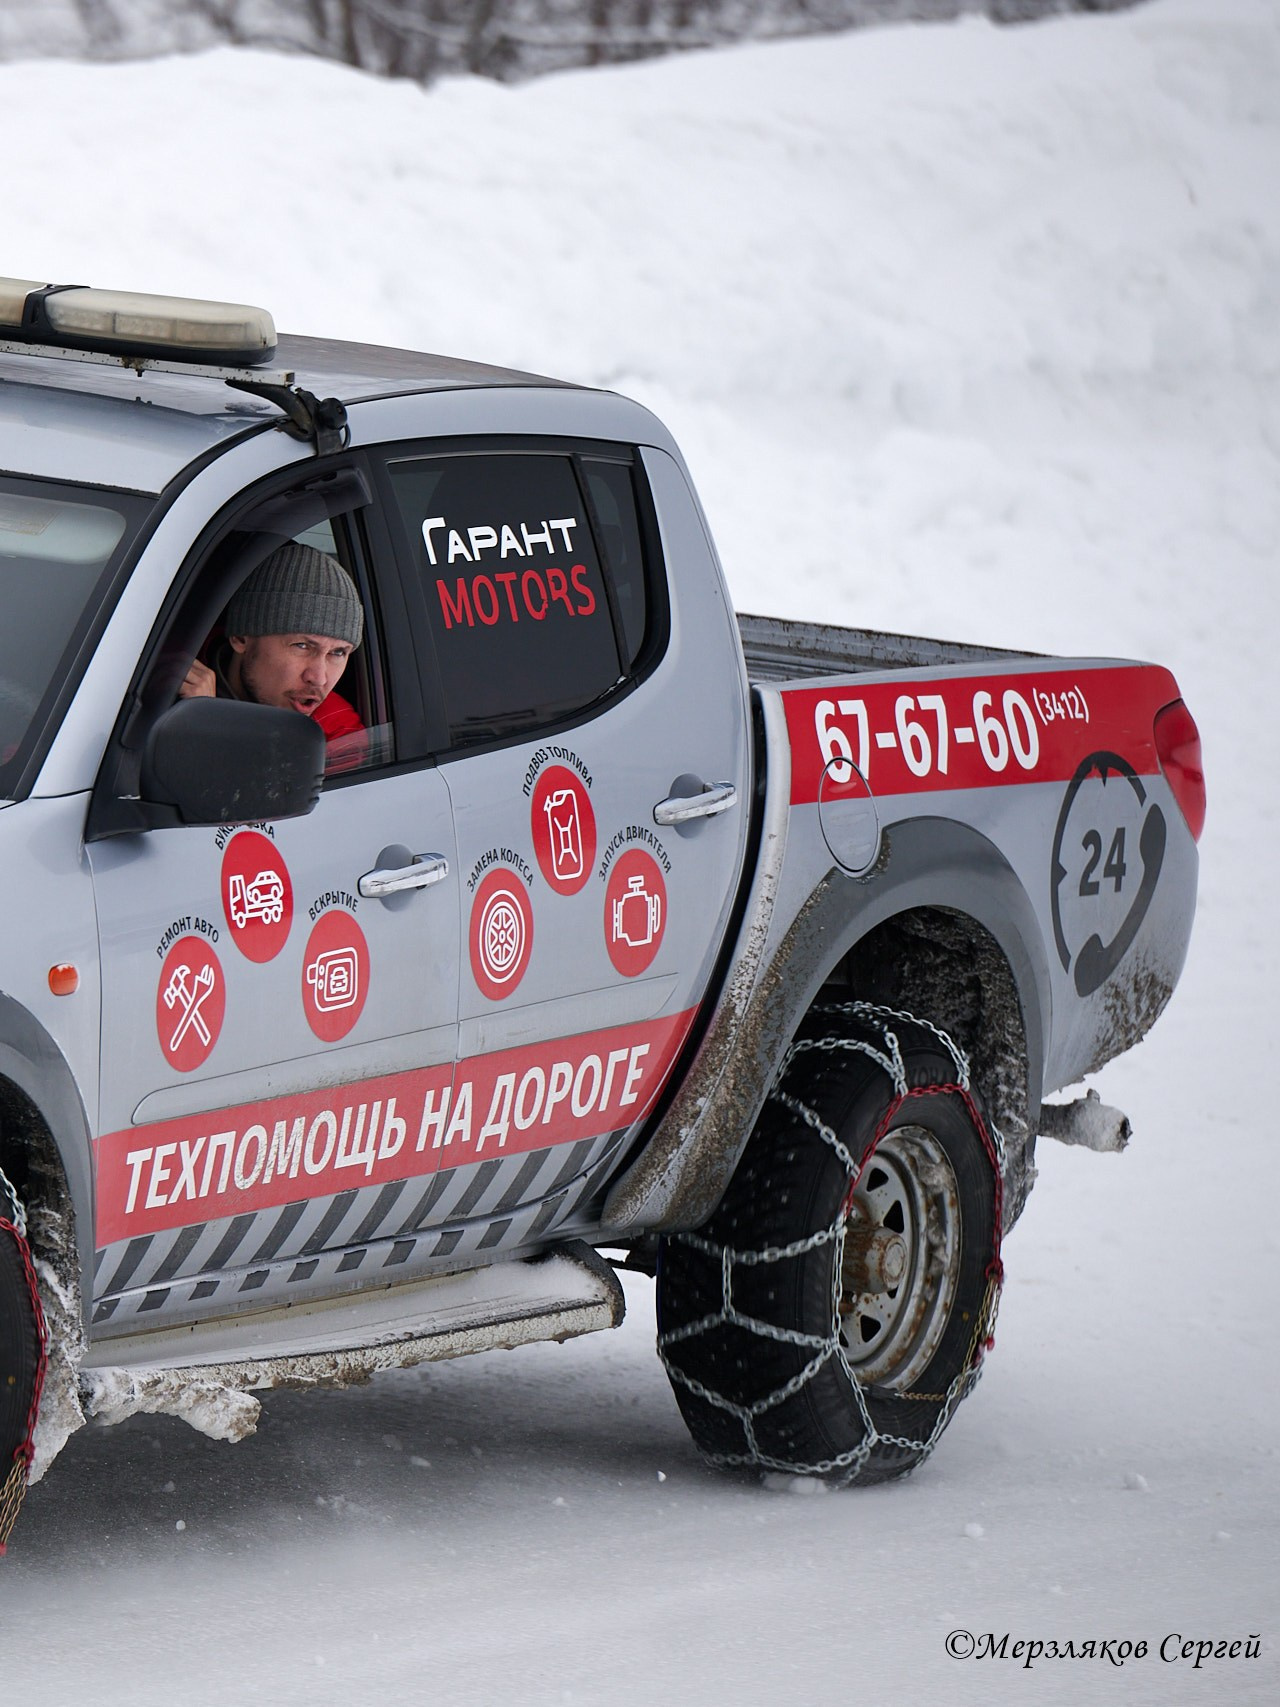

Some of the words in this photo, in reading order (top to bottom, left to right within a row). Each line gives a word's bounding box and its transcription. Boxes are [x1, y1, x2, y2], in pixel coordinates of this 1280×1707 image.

[422, 517, 577, 565] ГАРАНТ
[436, 564, 596, 629] MOTORS
[815, 689, 1039, 783] 67-67-60
[1032, 685, 1090, 725] (3412)
[522, 748, 549, 796] ПОДВОЗ
[547, 746, 593, 788] ТОПЛИВА
[466, 848, 498, 893] ЗАМЕНА
[500, 847, 533, 886] КОЛЕСА
[599, 830, 626, 881] ЗАПУСК
[626, 825, 671, 873] ДВИГАТЕЛЯ
[1078, 827, 1126, 897] 24
[308, 891, 358, 921] ВСКРЫТИЕ
[157, 916, 192, 959] РЕМОНТ
[194, 917, 219, 943] АВТО
[125, 1097, 407, 1213] ТЕХПОМОЩЬ
[415, 1081, 474, 1151] НА
[476, 1043, 650, 1152] ДОРОГЕ
